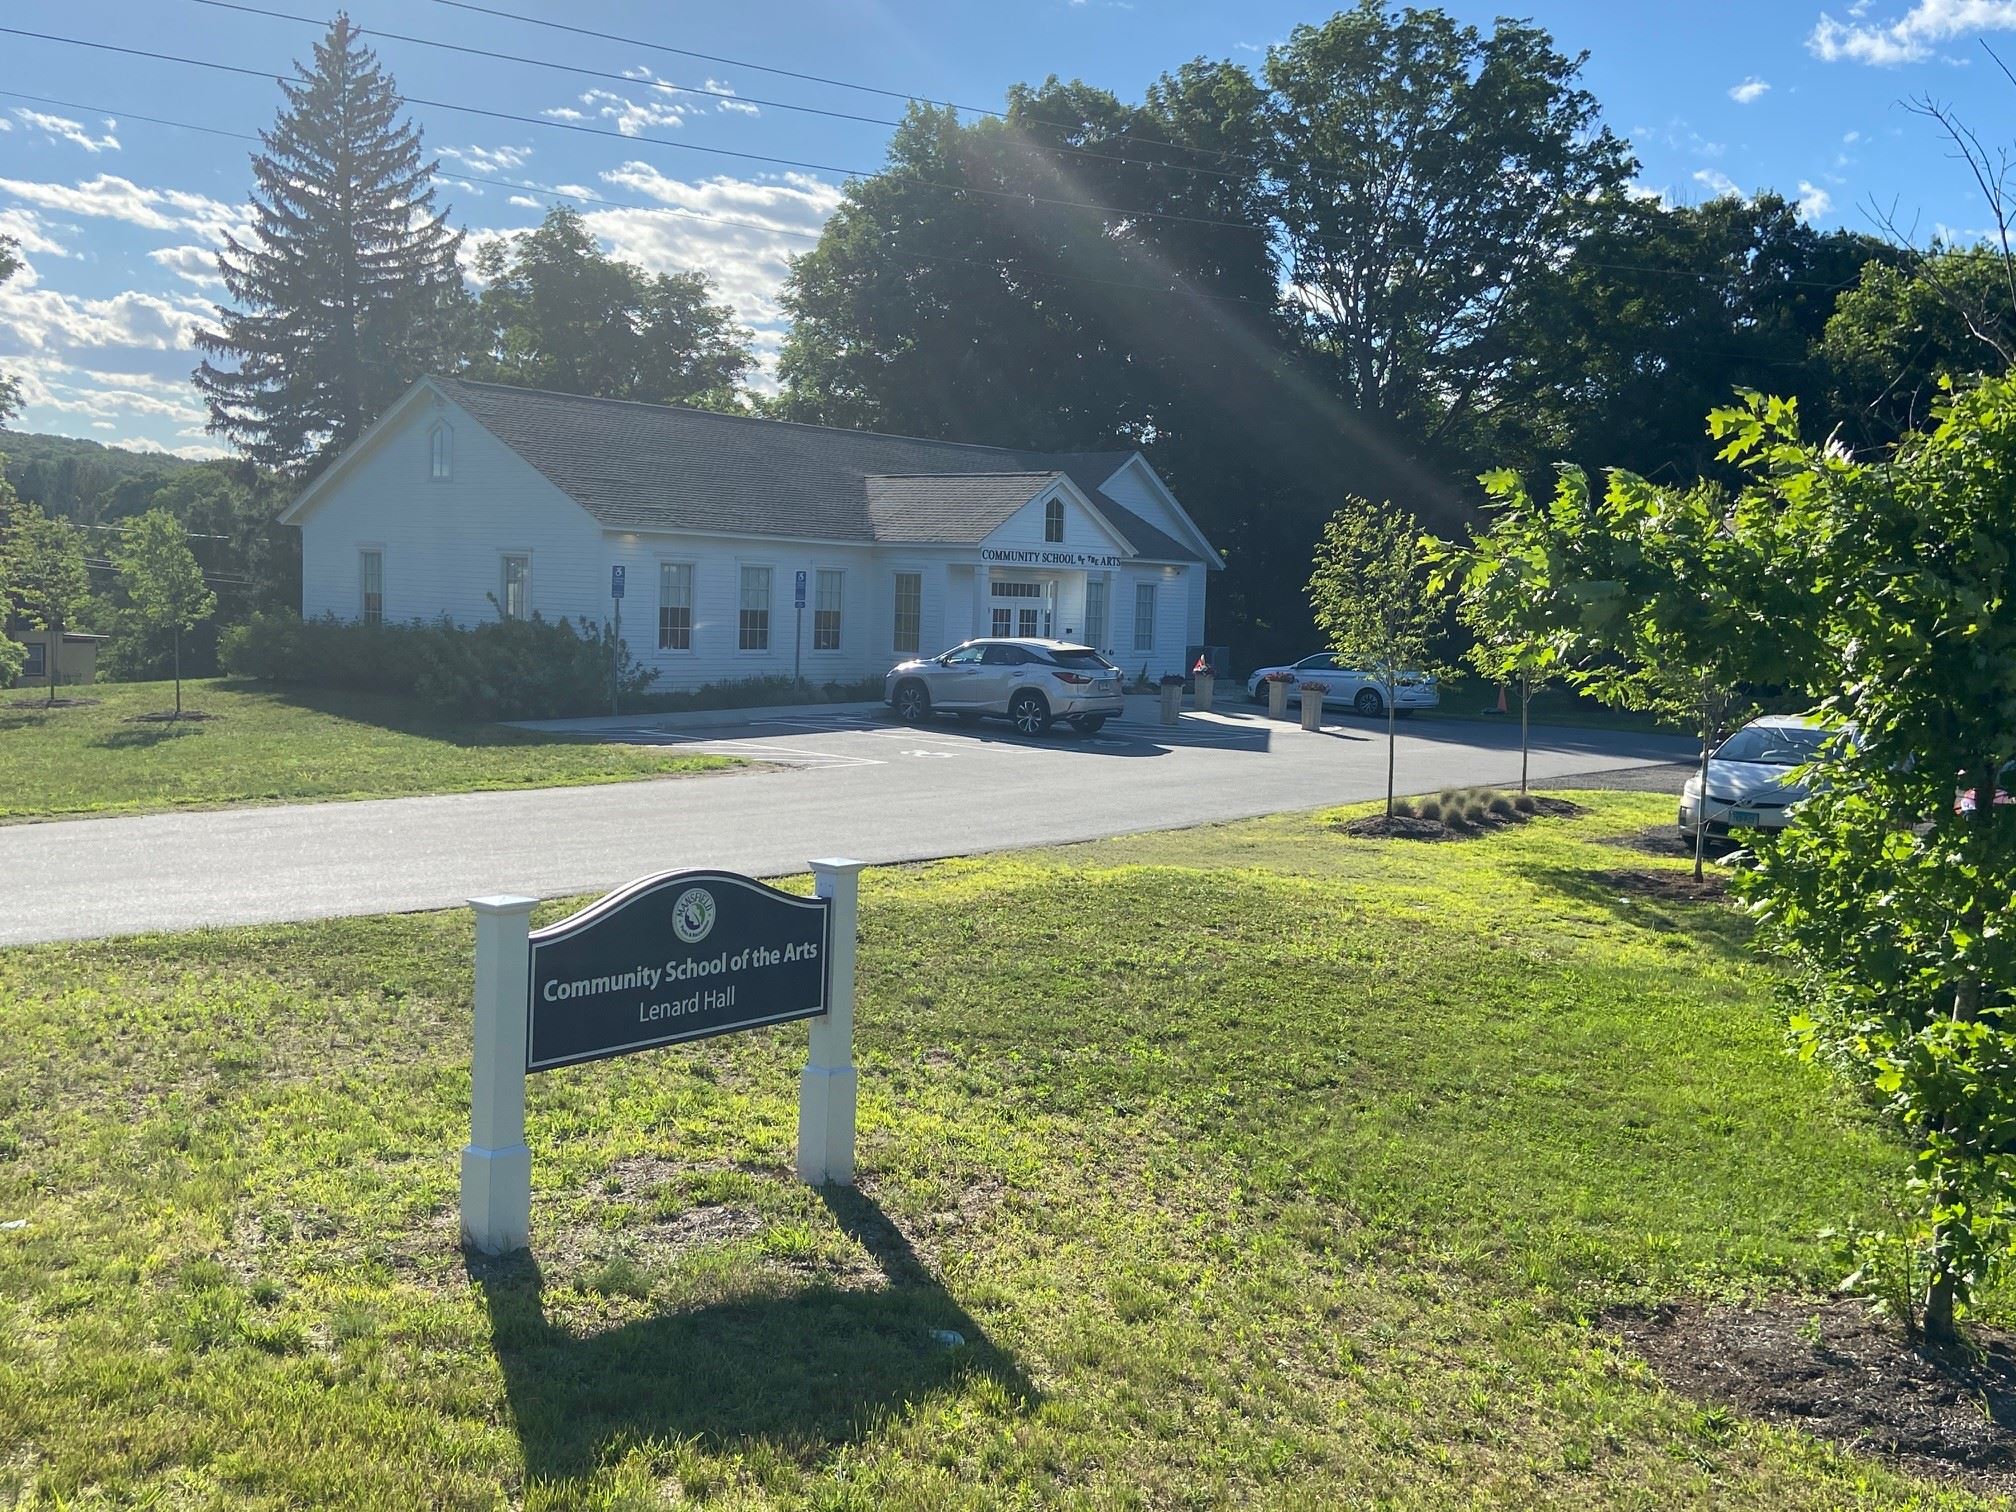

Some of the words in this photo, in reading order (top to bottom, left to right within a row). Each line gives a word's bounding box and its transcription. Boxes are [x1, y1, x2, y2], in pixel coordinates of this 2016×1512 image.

[982, 549, 1040, 563] COMMUNITY
[1042, 553, 1076, 565] SCHOOL
[1100, 556, 1121, 567] ARTS
[677, 892, 713, 918] MANSFIELD
[543, 965, 662, 1002] Community
[665, 951, 727, 982] School
[730, 948, 750, 971] of
[752, 946, 781, 968] the
[783, 941, 818, 963] Arts
[639, 991, 699, 1023] Lenard
[704, 984, 736, 1011] Hall
